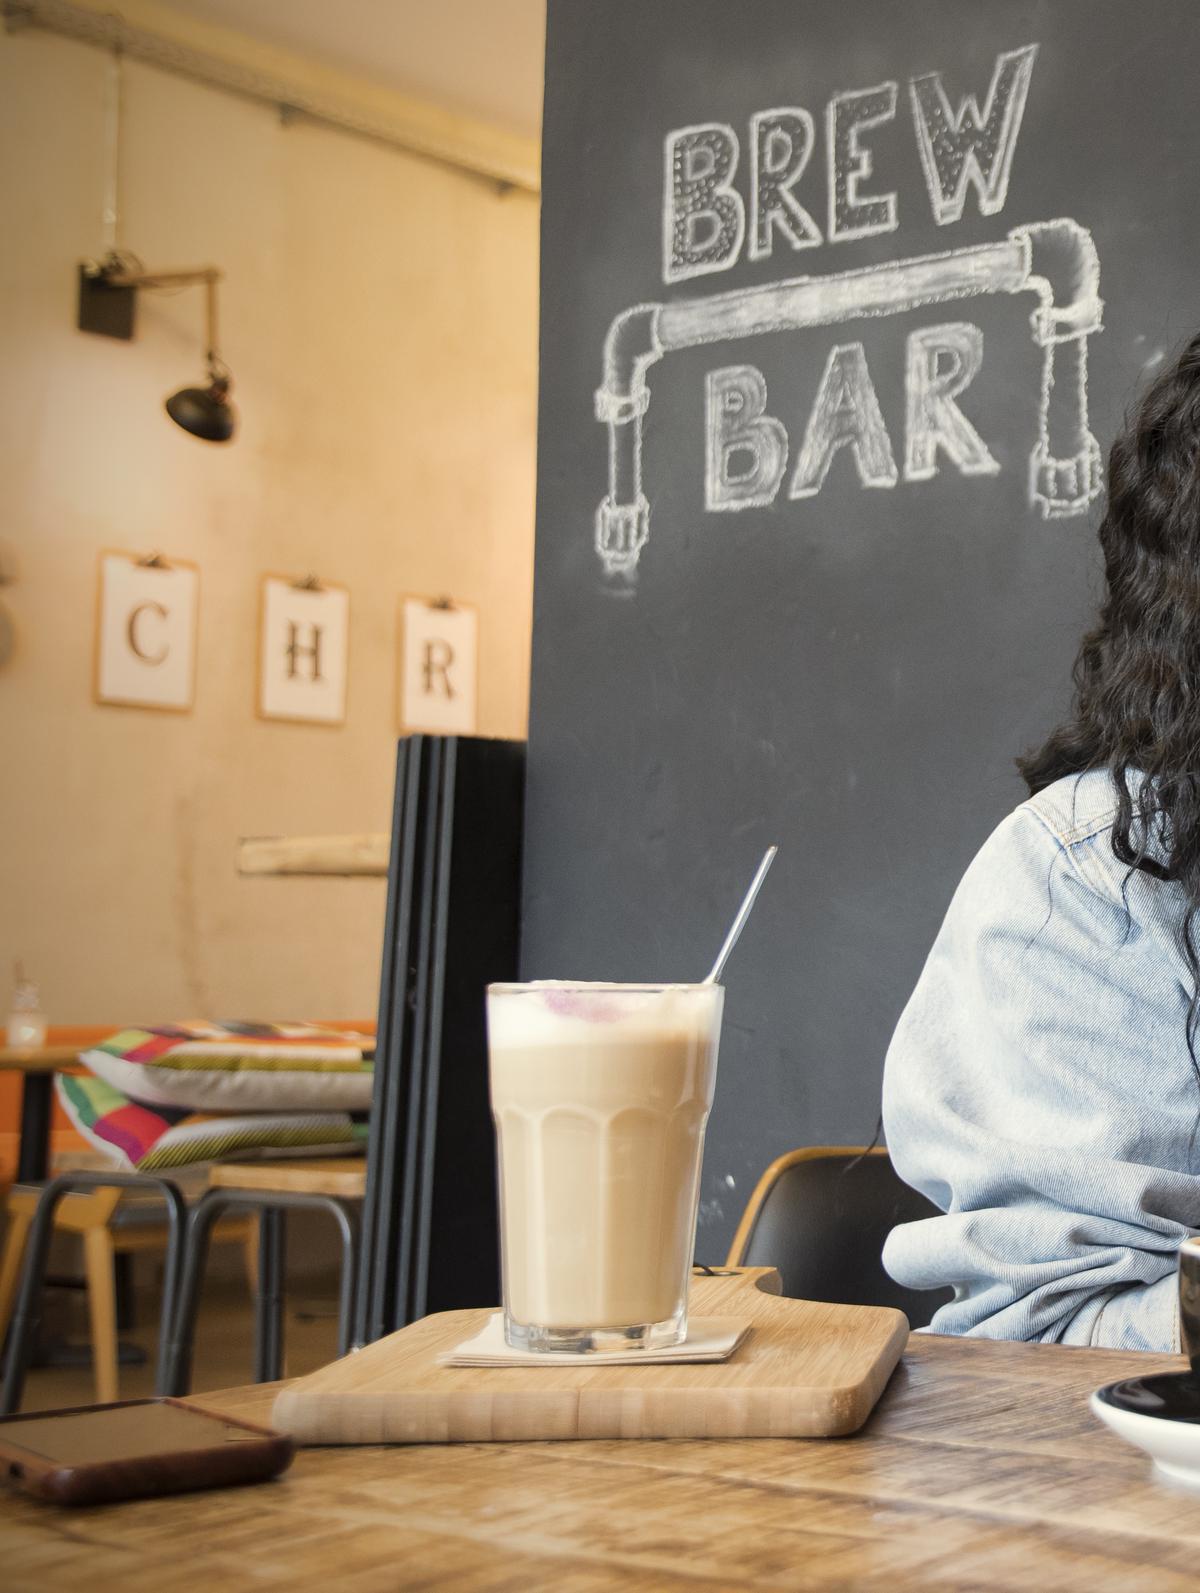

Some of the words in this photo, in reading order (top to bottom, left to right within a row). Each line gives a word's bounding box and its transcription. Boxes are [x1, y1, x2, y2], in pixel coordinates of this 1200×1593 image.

[661, 42, 1041, 285] BREW
[704, 321, 1001, 513] BAR
[126, 600, 170, 667] C
[286, 618, 326, 684] H
[420, 636, 456, 701] R
